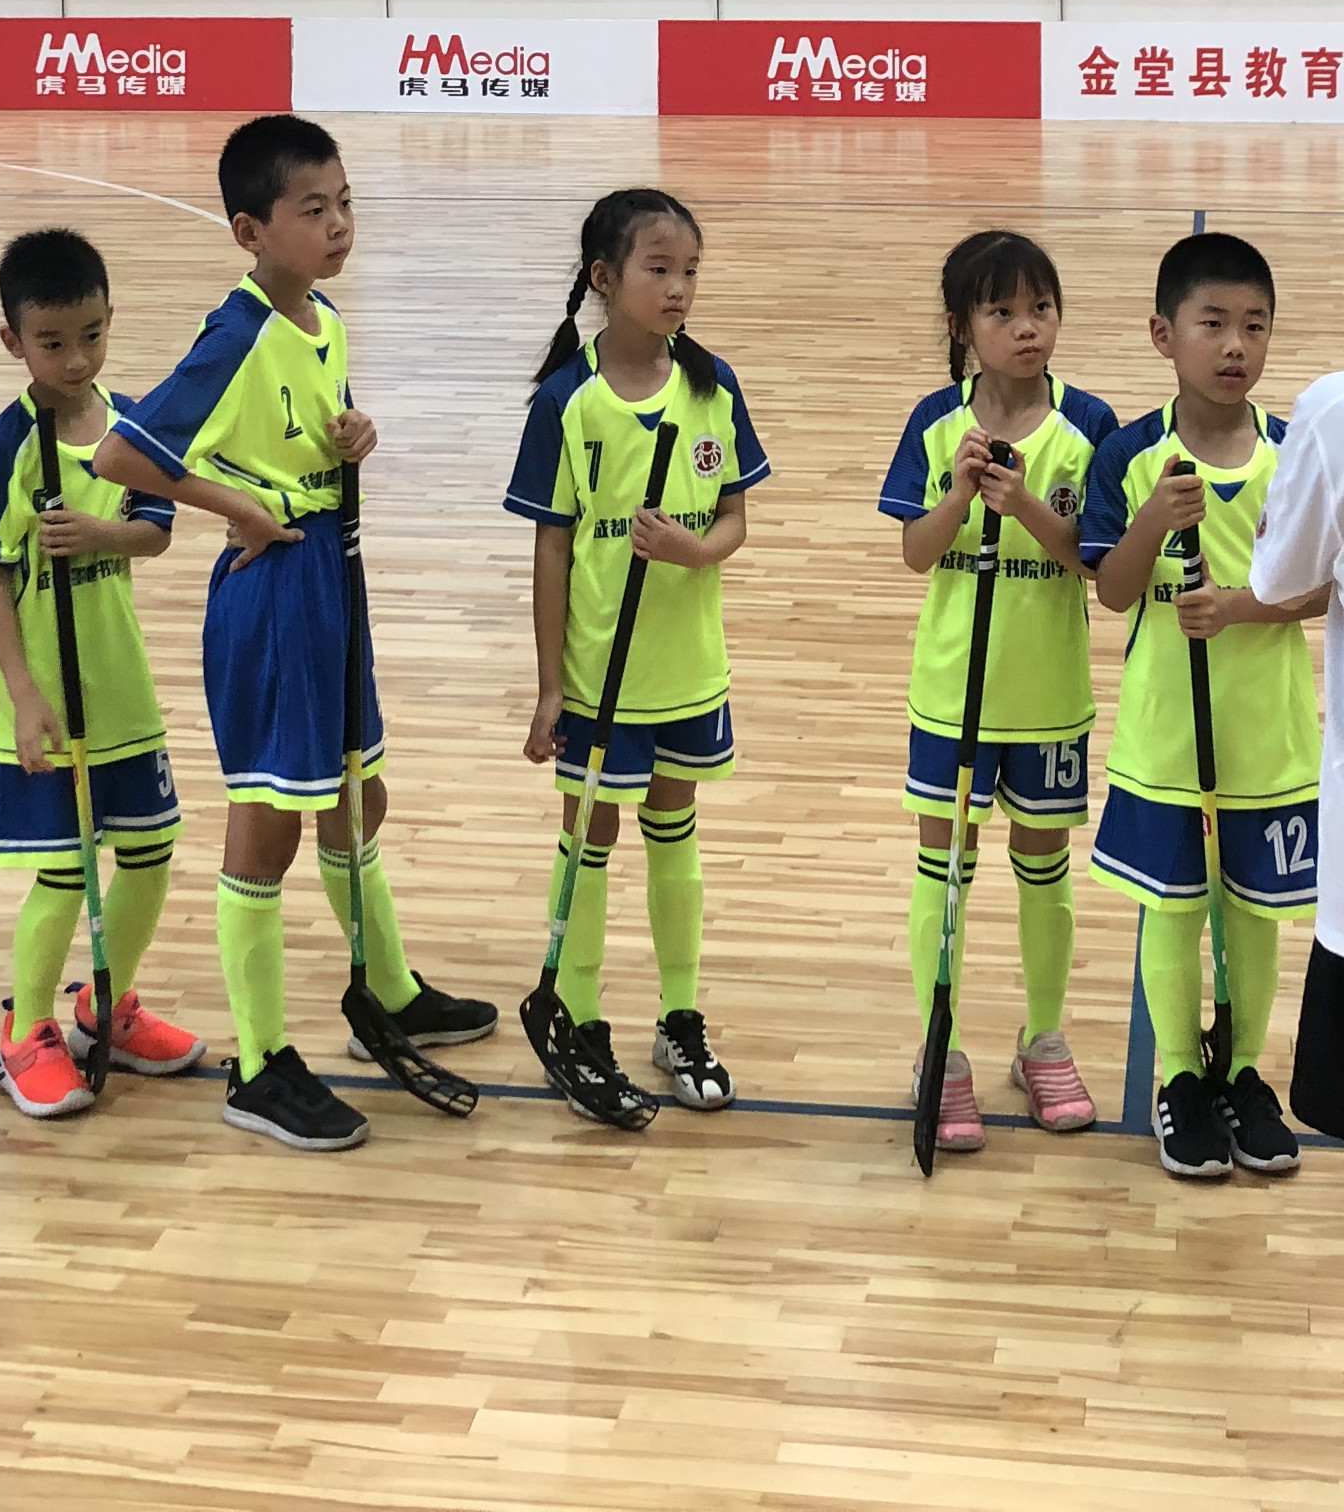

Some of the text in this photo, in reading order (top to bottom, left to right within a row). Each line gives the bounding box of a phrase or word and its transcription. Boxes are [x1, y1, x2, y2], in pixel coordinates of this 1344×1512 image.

[36, 33, 186, 76] HMedia
[398, 33, 550, 76] HMedia
[767, 36, 926, 81] HMedia
[36, 76, 187, 96] 虎马传媒
[398, 78, 550, 98] 虎马传媒
[767, 82, 927, 102] 虎马传媒
[281, 386, 304, 440] 2
[584, 441, 602, 492] 7
[1039, 742, 1080, 788] 15
[1265, 815, 1315, 875] 12
